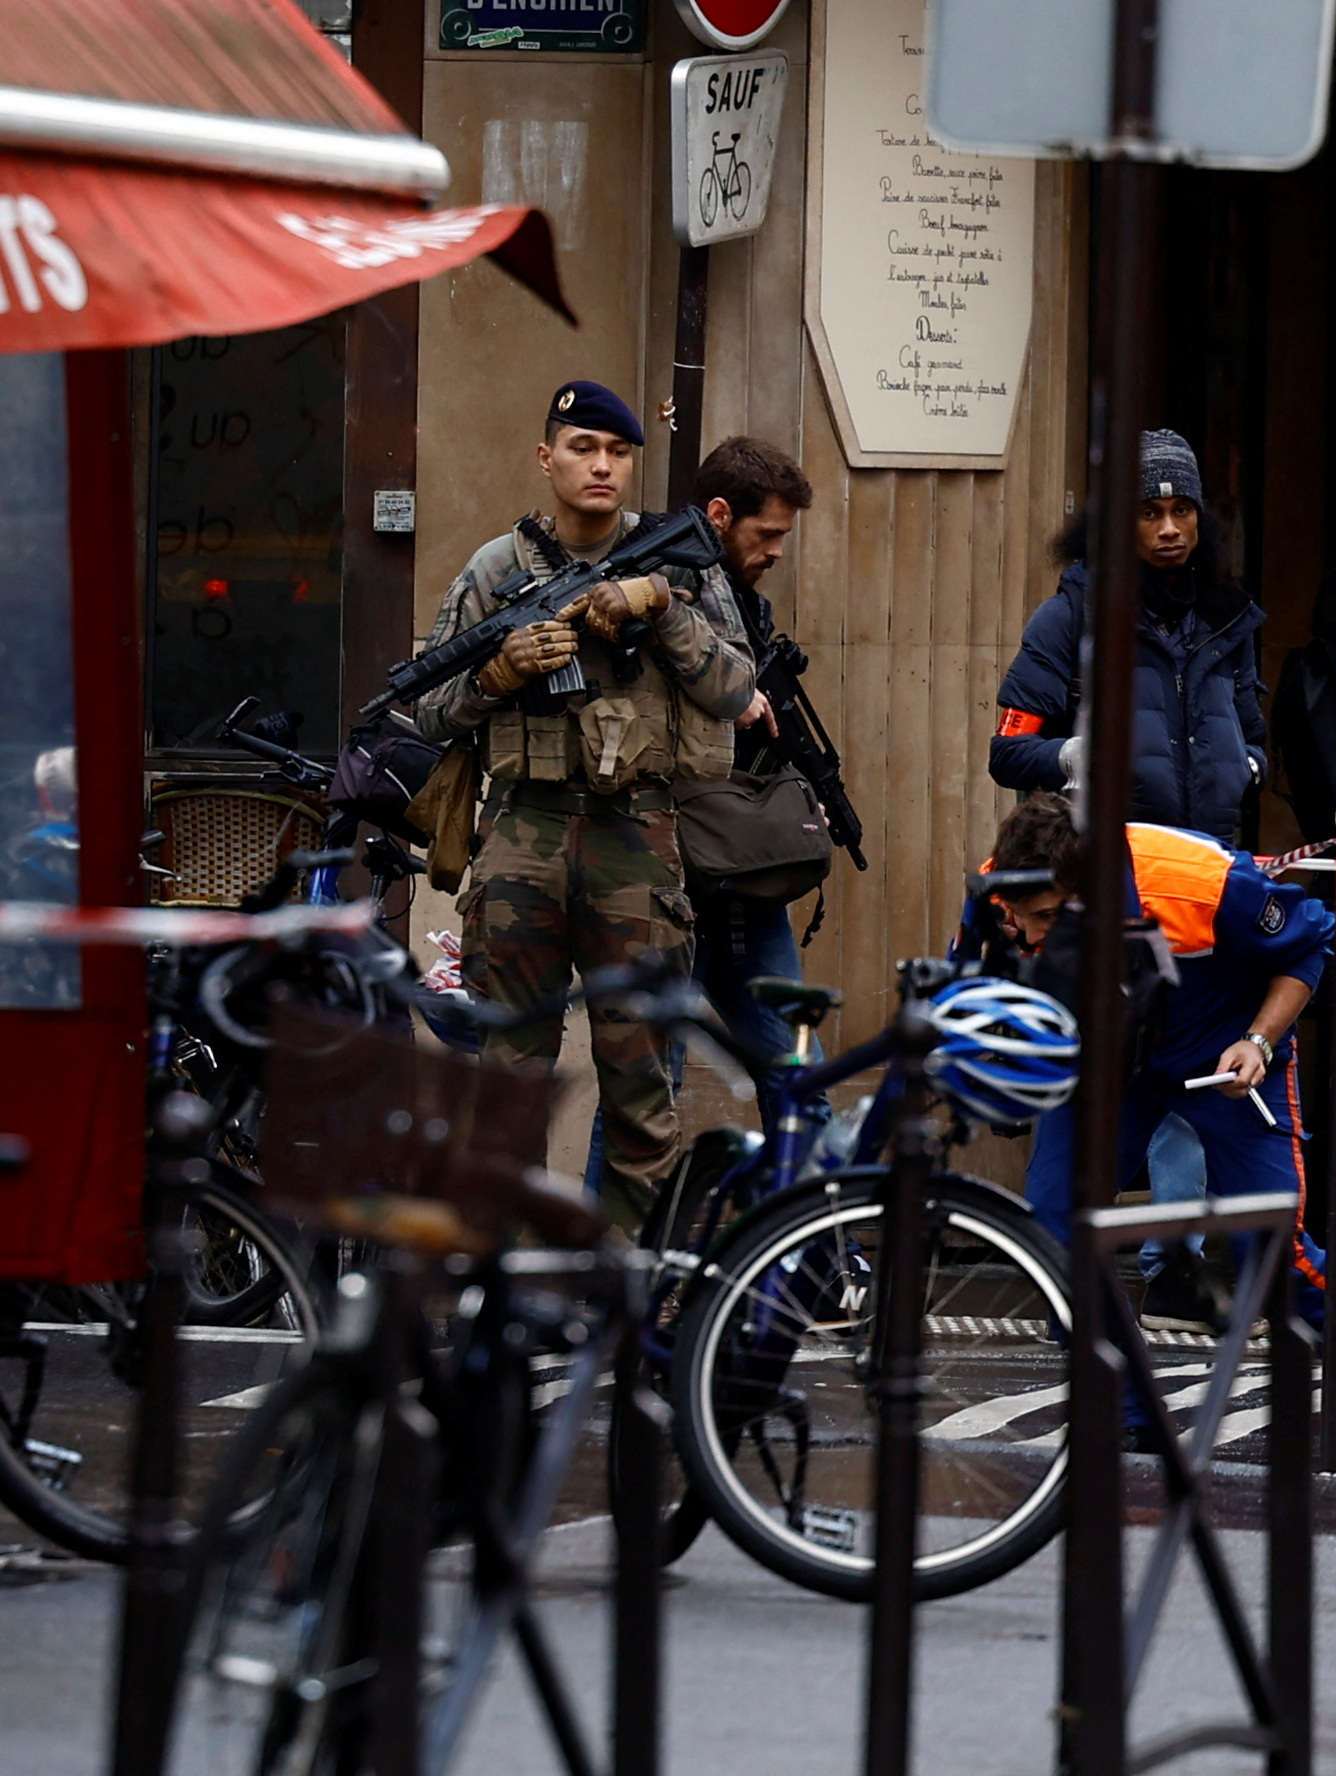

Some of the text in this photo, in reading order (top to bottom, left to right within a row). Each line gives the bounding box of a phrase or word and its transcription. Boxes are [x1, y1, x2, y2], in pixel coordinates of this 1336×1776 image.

[705, 67, 765, 115] SAUF
[902, 191, 914, 203] de
[887, 229, 919, 255] Cuisse
[921, 243, 933, 257] de
[899, 344, 921, 379] Café
